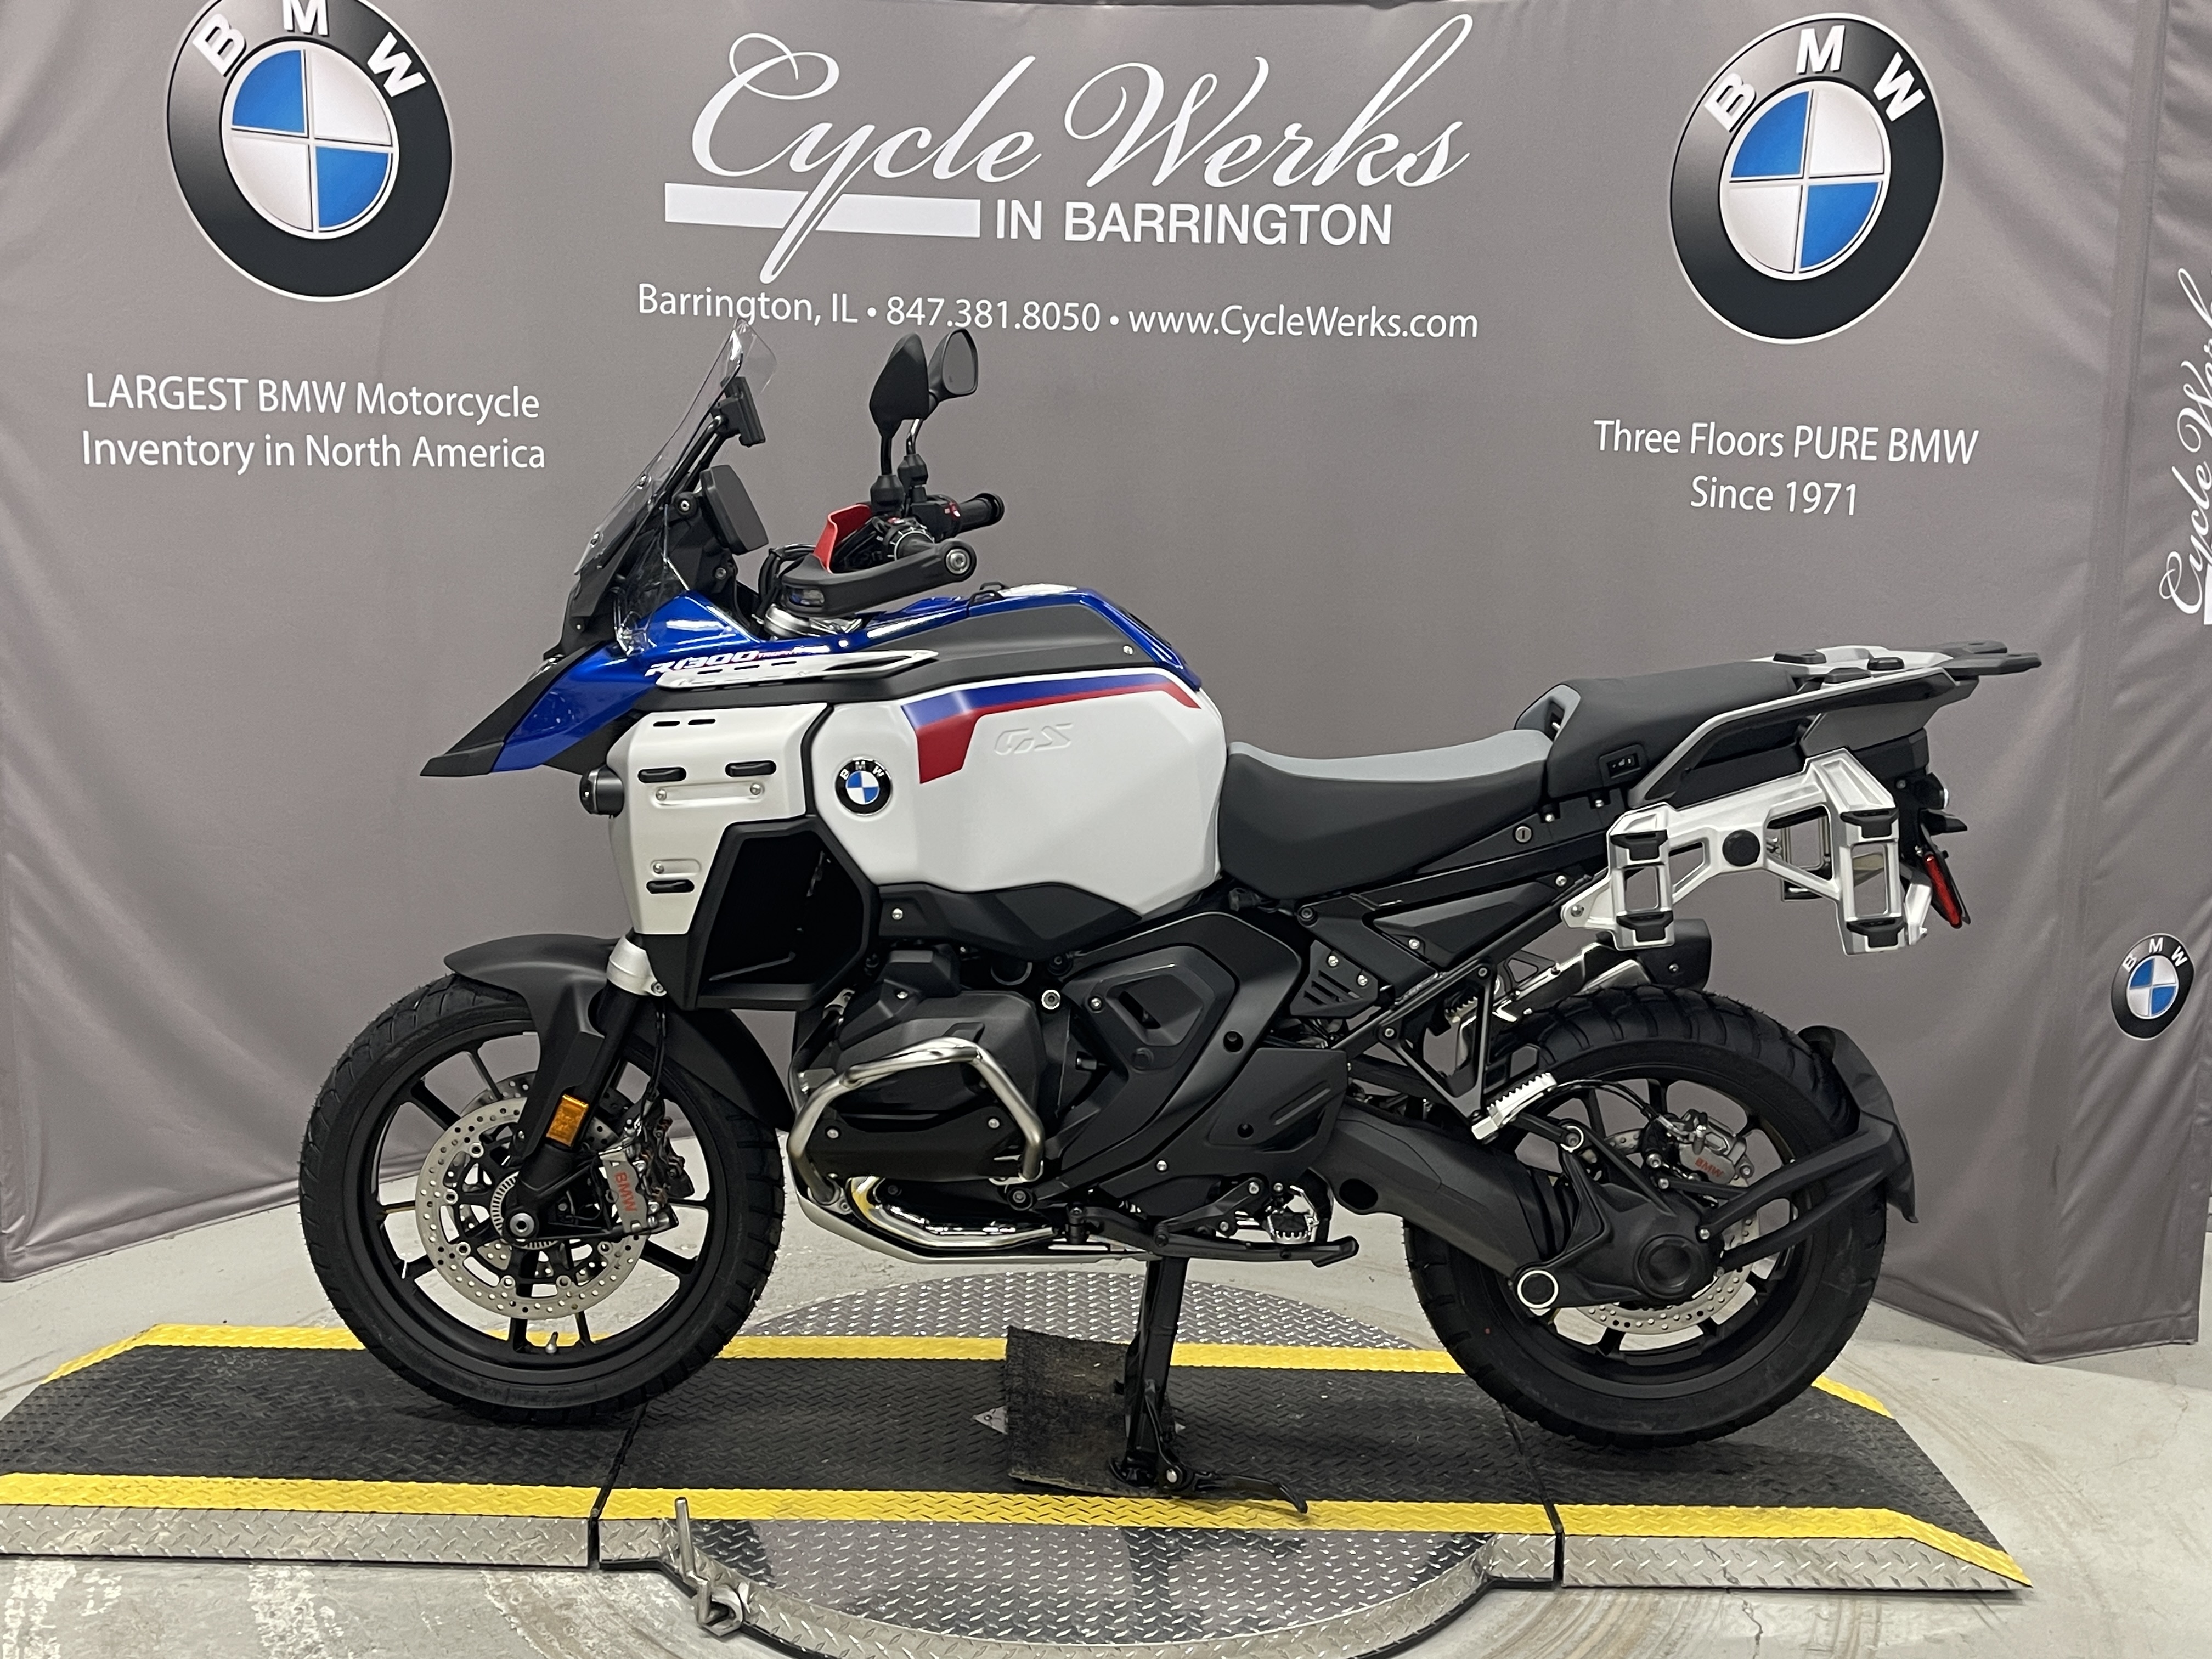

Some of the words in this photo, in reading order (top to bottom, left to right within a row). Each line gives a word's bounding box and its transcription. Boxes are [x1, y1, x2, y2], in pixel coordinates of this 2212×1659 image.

[192, 0, 427, 98] BMW
[1703, 25, 1926, 132] BMW
[691, 32, 1042, 284] Cycle
[1064, 13, 1474, 188] Werks
[996, 199, 1042, 240] IN
[1064, 201, 1392, 246] BARRINGTON
[638, 283, 821, 326] Barrington,
[832, 292, 859, 323] IL
[886, 296, 1101, 333] 847.381.8050
[1128, 302, 1479, 344] www.CycleWerks.com
[86, 372, 249, 411] LARGEST
[258, 379, 347, 414] BMW
[356, 382, 540, 426] Motorcycle
[82, 430, 256, 476] Inventory
[264, 433, 295, 466] in
[306, 433, 401, 467] North
[411, 436, 545, 469] America
[1593, 419, 1681, 454] Three
[1690, 421, 1785, 458] Floors
[1793, 425, 1880, 461] PURE
[1888, 427, 1980, 465] BMW
[1690, 475, 1774, 511] Since
[1786, 481, 1857, 516] 1971
[994, 721, 1074, 756] GS
[840, 760, 884, 780] BMW
[2121, 937, 2188, 973] BMW
[1695, 1157, 1724, 1178] BMW
[614, 1171, 637, 1212] BMW
